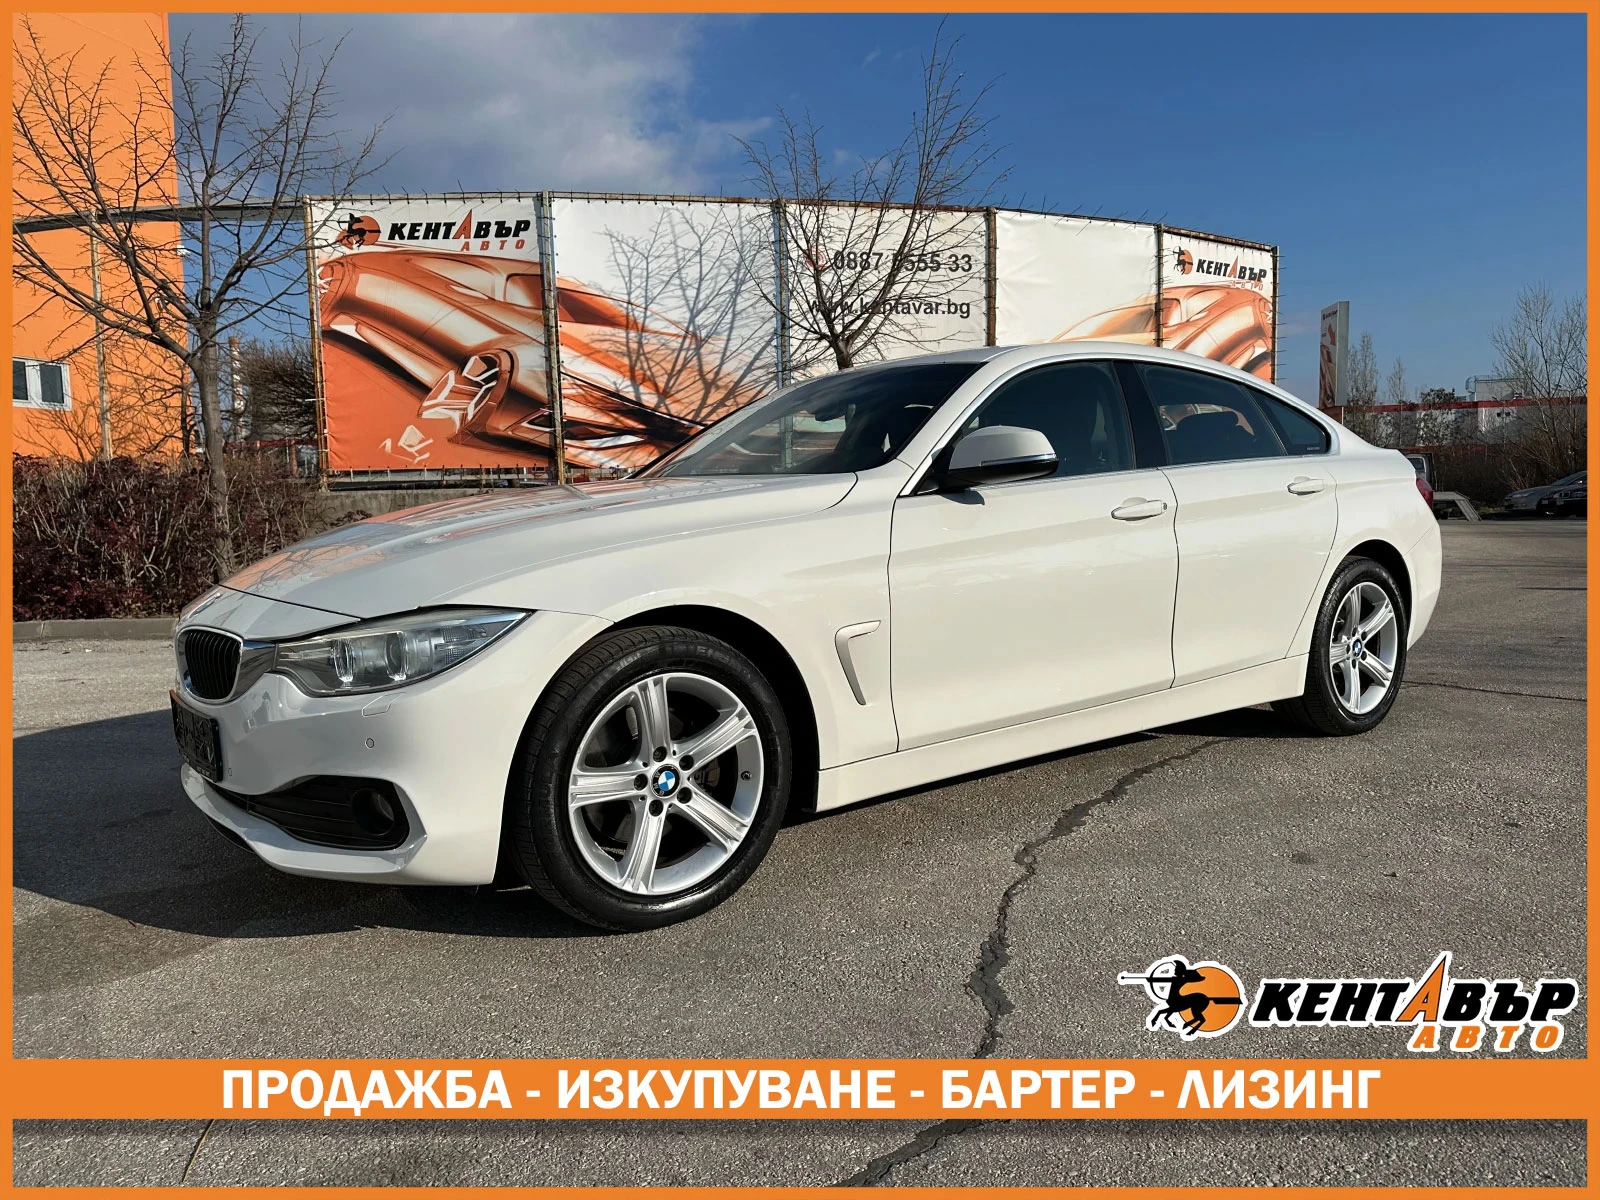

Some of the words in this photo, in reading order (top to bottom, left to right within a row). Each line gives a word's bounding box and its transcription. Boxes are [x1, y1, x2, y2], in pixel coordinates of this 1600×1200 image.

[388, 209, 530, 240] КЕНТАВЪР
[461, 239, 525, 251] АВТО
[833, 250, 883, 271] 0887
[892, 252, 941, 272] 555
[949, 253, 972, 272] 33
[1196, 256, 1267, 282] КЕНТАВЪР
[1231, 280, 1263, 291] АВТО
